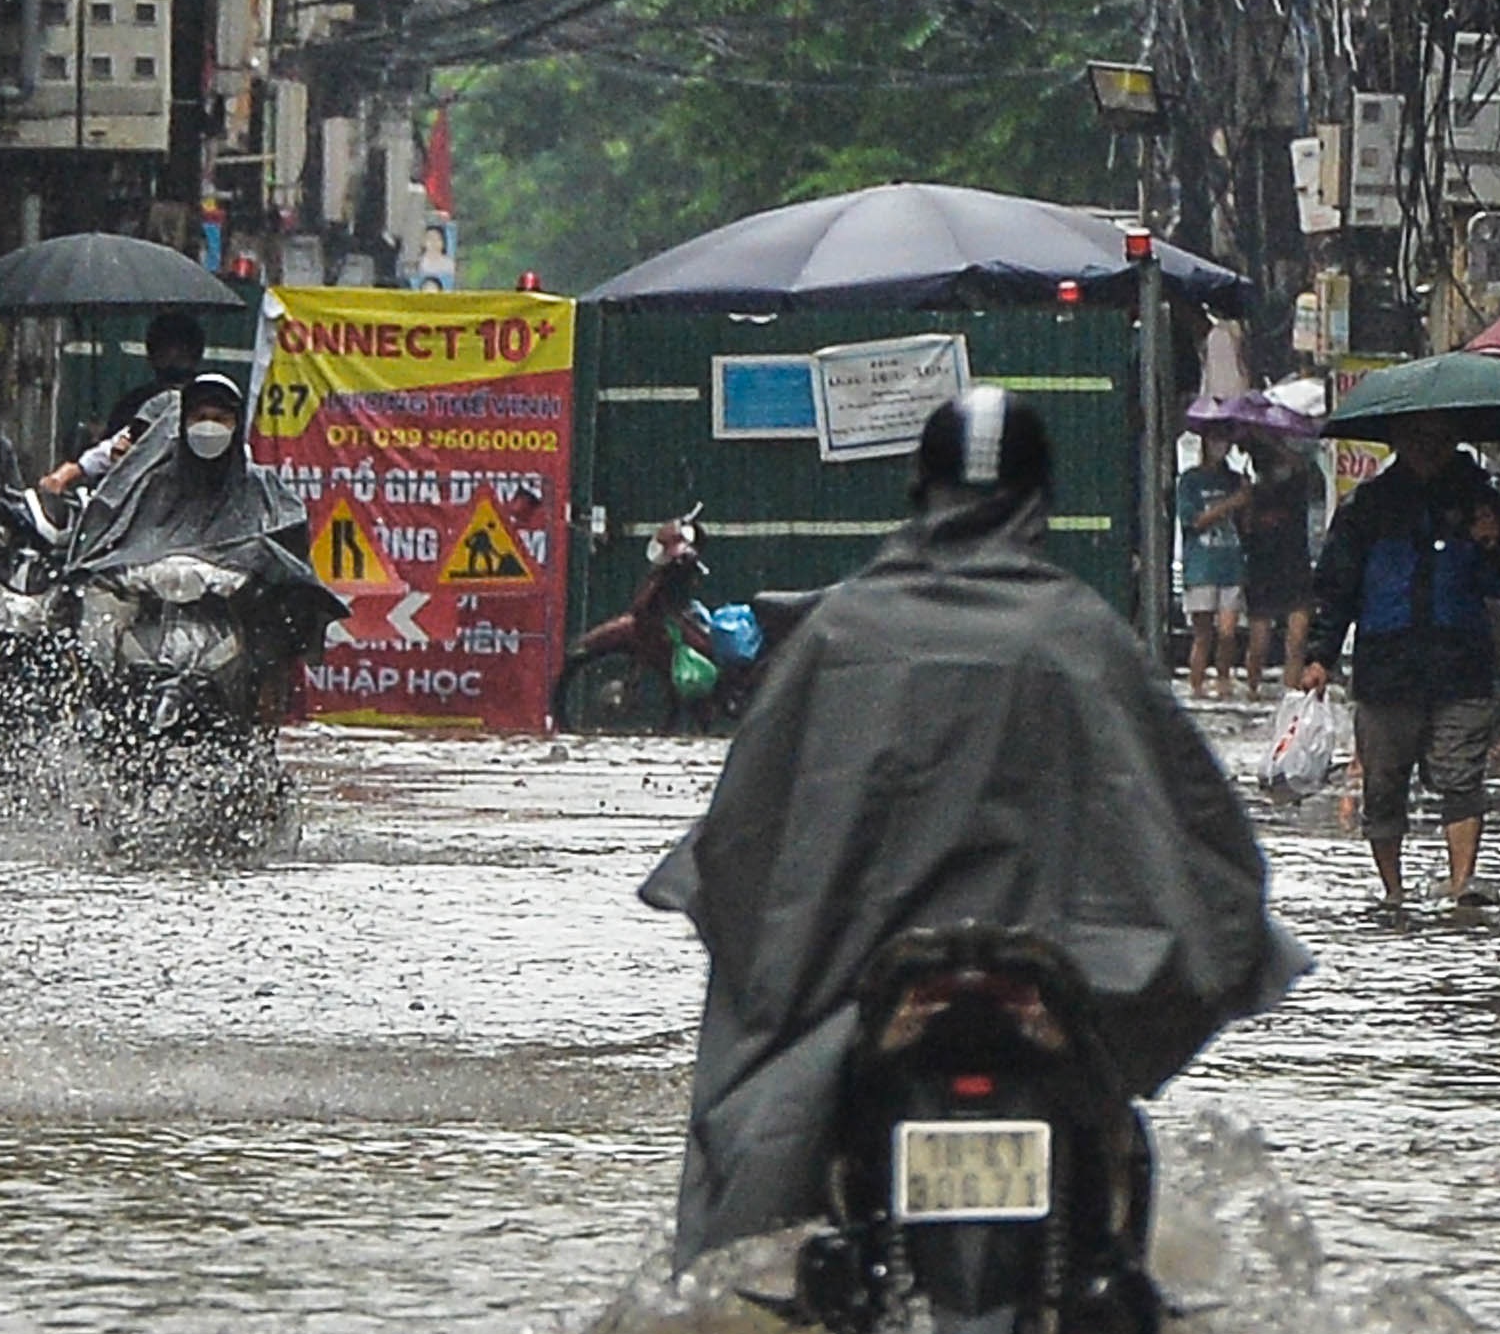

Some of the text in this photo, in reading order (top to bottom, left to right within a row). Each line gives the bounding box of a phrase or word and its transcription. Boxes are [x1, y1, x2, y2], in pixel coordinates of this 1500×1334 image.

[276, 319, 466, 360] ONNECT
[384, 467, 441, 505] GIA
[304, 659, 482, 703] NHẬP HỌC
